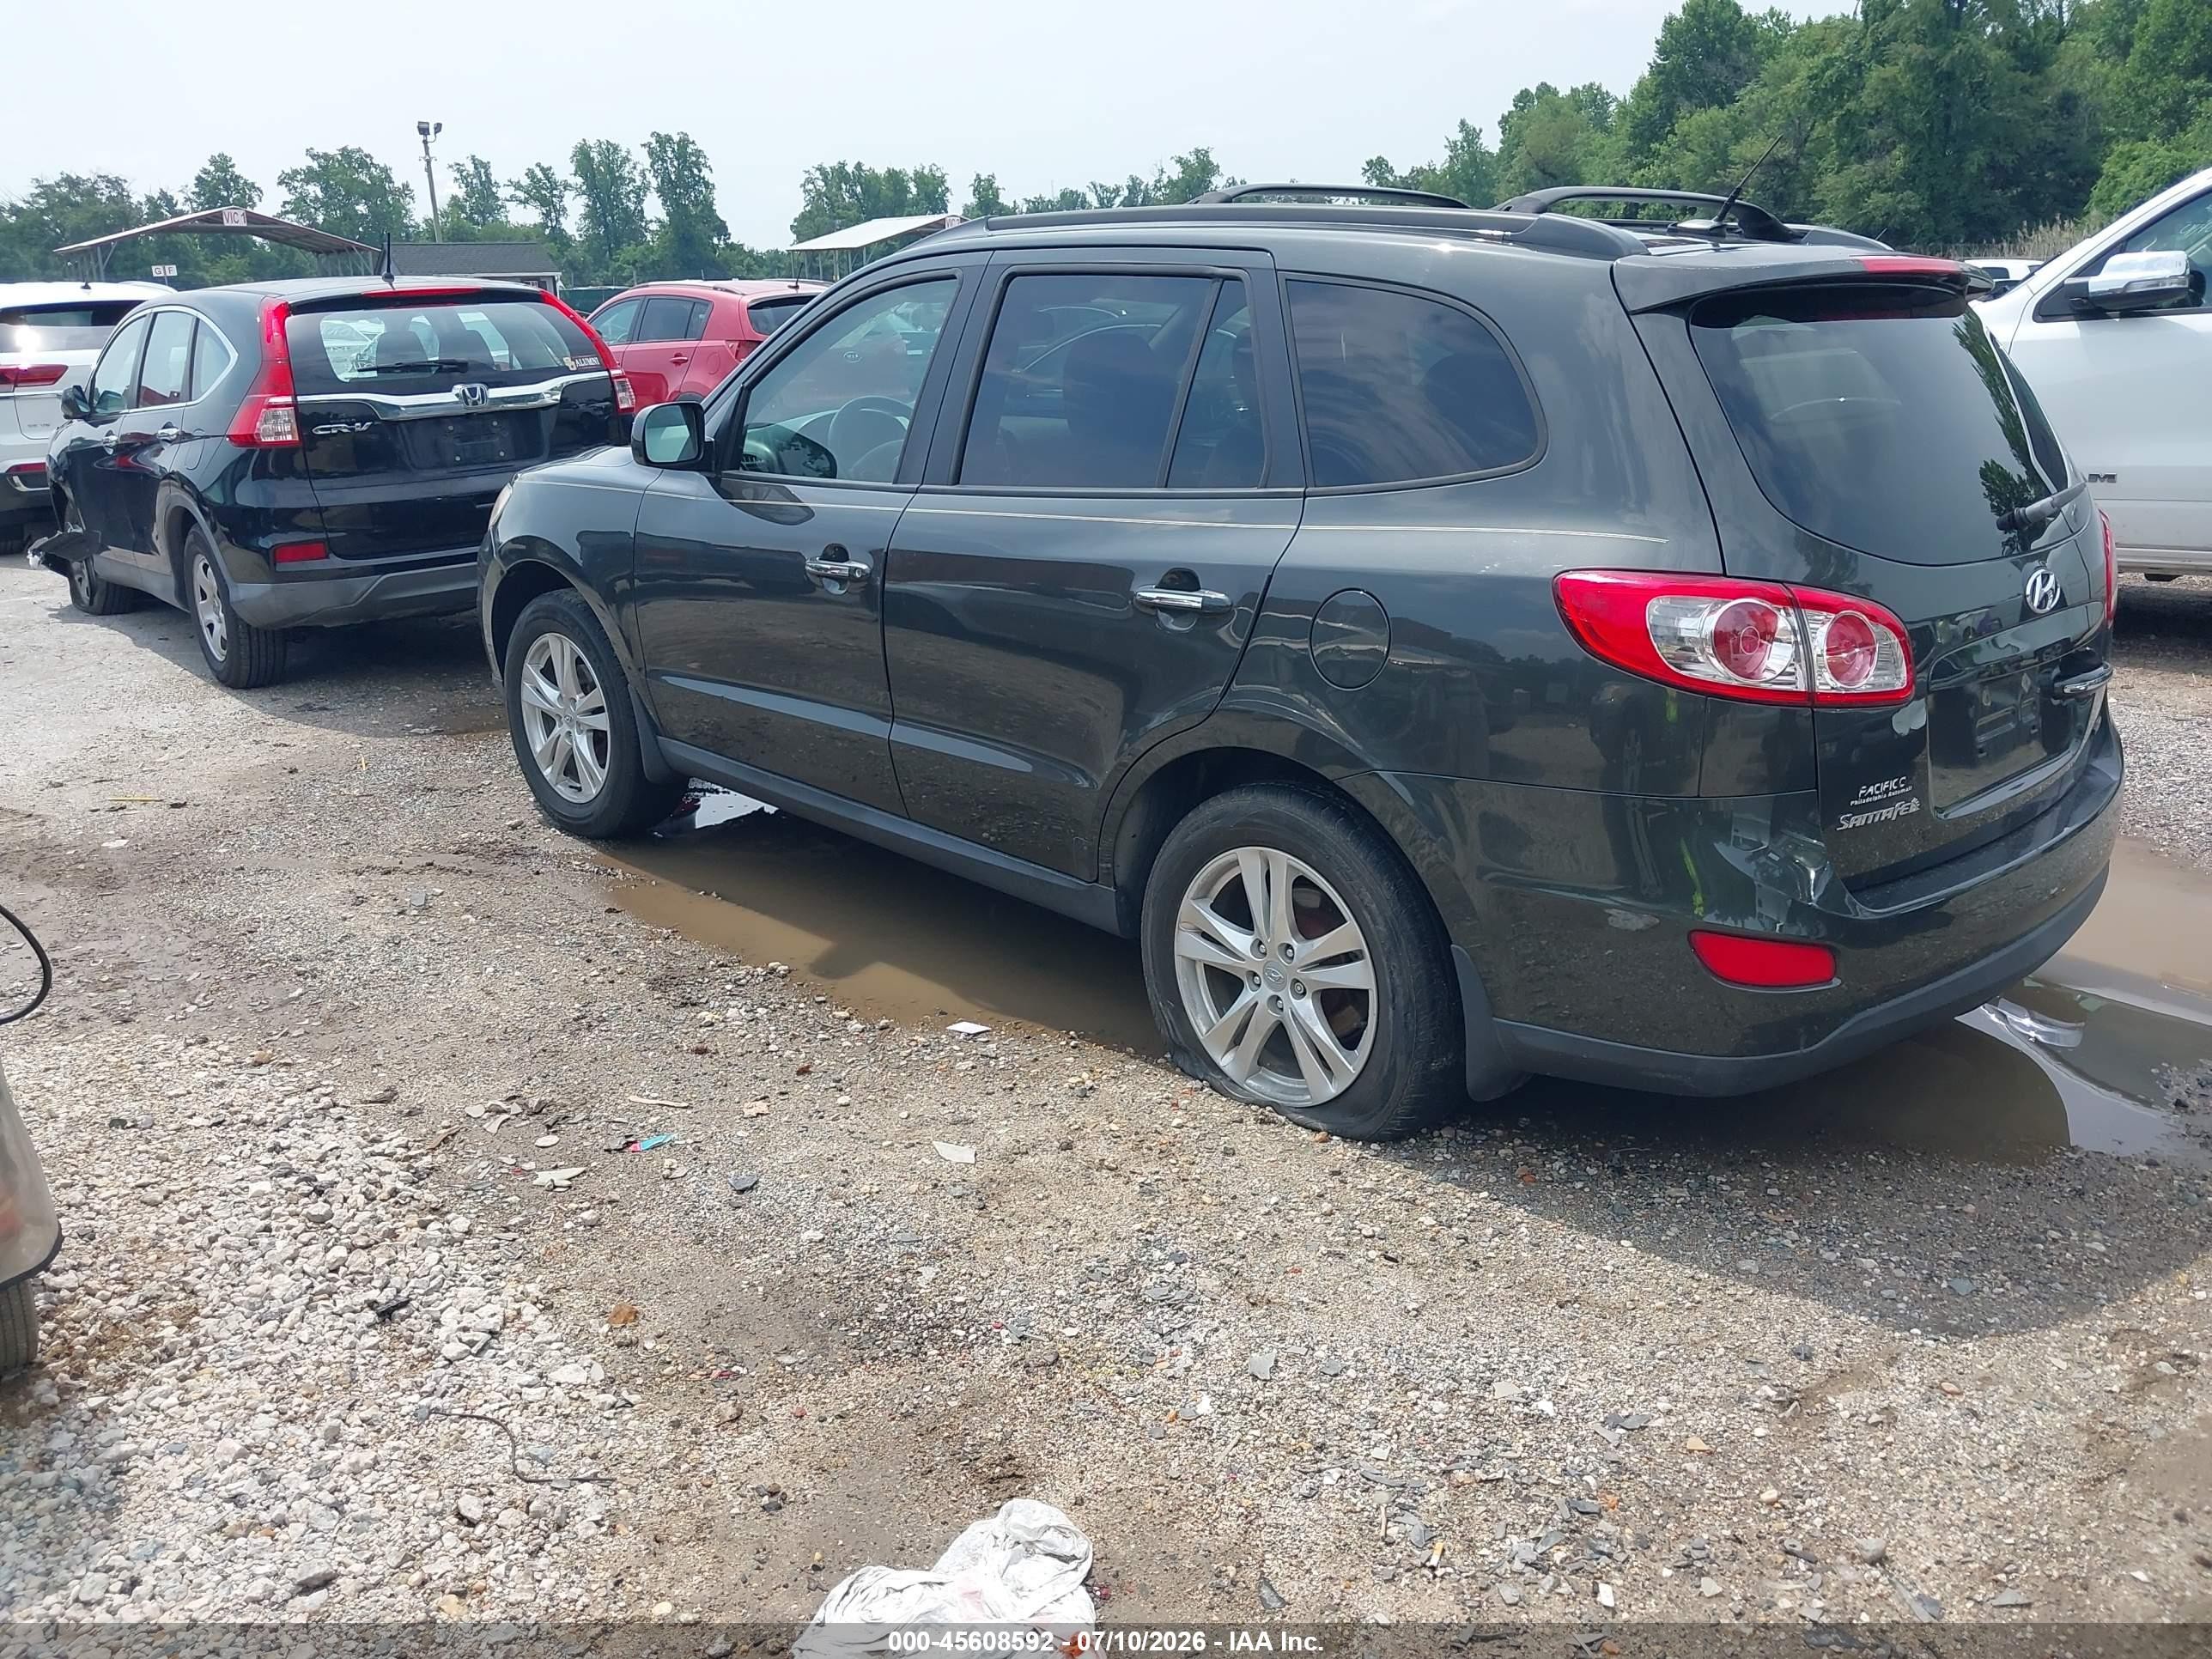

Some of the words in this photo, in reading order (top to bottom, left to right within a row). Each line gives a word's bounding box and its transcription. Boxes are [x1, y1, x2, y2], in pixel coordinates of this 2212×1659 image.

[222, 211, 240, 224] VIC
[240, 212, 246, 224] 1
[575, 356, 600, 368] ALUMNI
[312, 422, 373, 434] CR-V
[1850, 793, 1887, 807] Philadelphia
